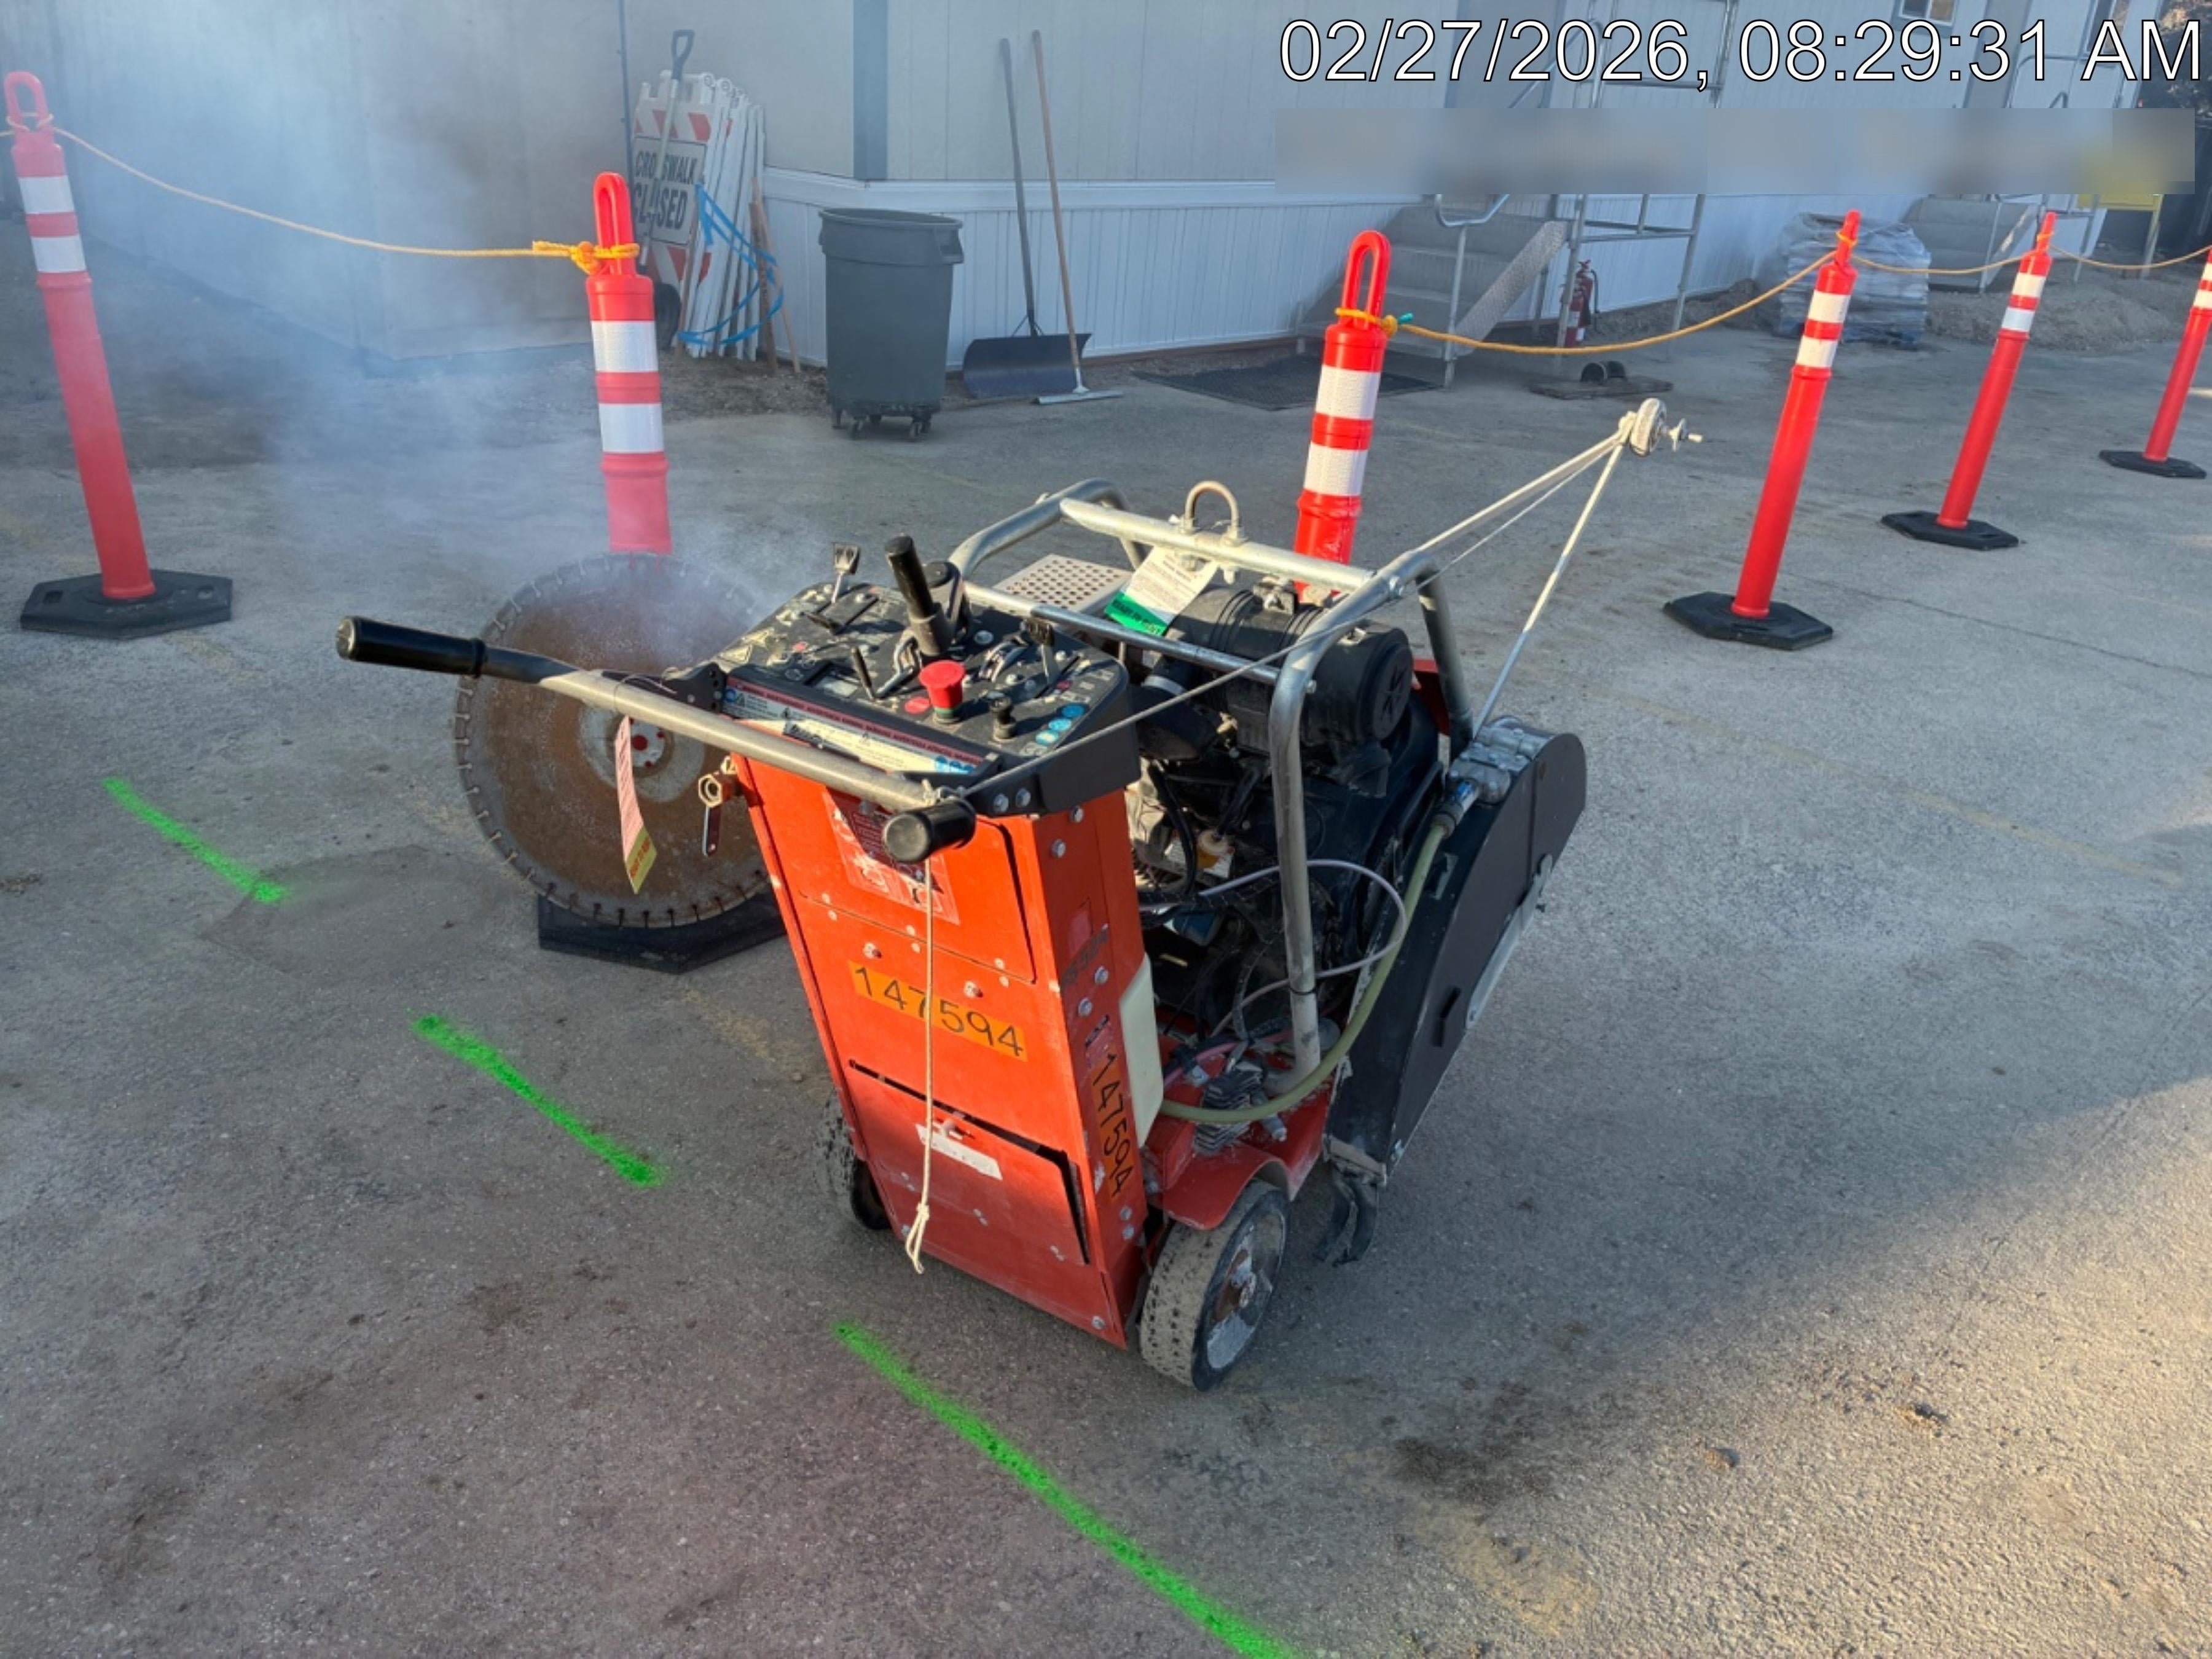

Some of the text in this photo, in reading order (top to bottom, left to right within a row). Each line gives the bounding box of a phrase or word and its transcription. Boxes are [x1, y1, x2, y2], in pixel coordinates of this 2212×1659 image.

[635, 151, 698, 185] CROSWALK
[855, 967, 1023, 1057] 147594
[1092, 1053, 1135, 1197] 147594
